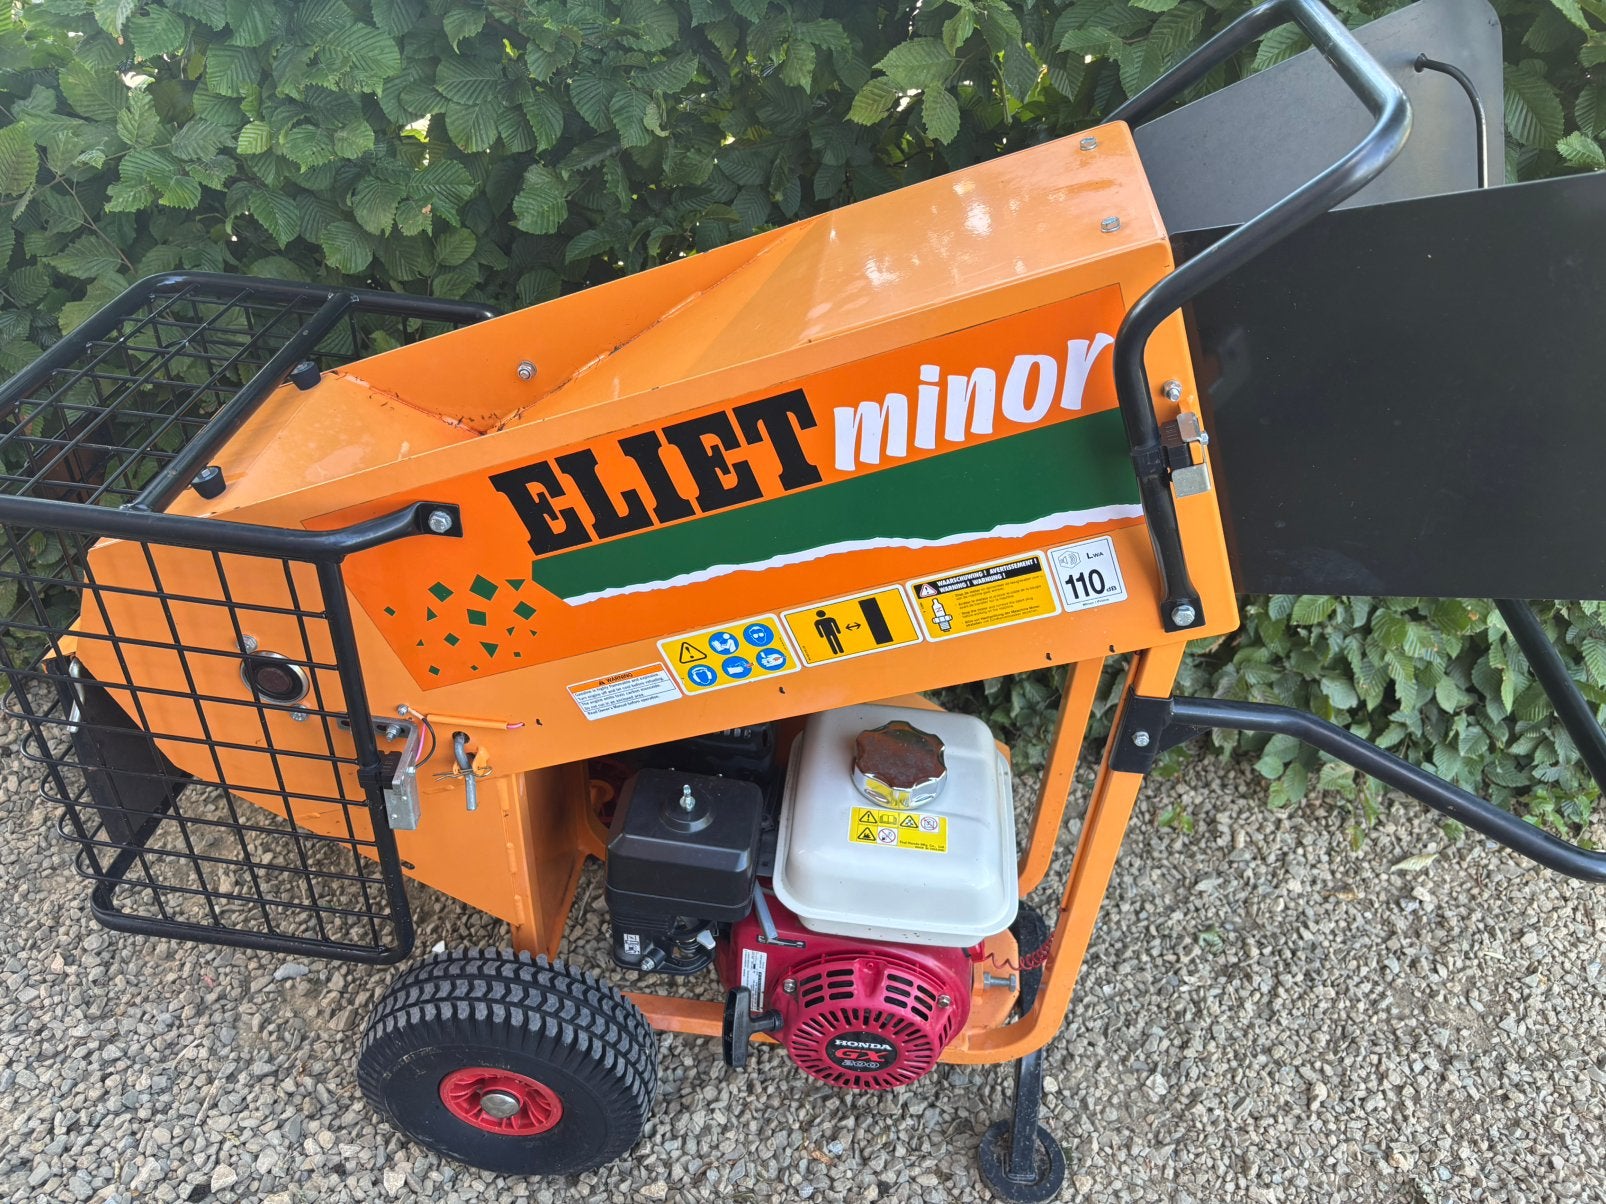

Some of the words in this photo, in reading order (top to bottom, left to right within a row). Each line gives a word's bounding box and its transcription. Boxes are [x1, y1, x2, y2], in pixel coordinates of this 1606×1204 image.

[488, 388, 822, 556] ELIET
[833, 332, 1115, 471] minor
[936, 571, 983, 586] WAARSCHUWING
[988, 559, 1033, 574] AVERTISSEMENT
[939, 582, 966, 592] WARNING
[972, 574, 1002, 585] WARNUNG
[1065, 569, 1105, 599] 110
[607, 673, 632, 682] WARNING
[835, 1040, 892, 1050] HONDA
[835, 1049, 889, 1062] GX
[842, 1060, 879, 1068] 200
